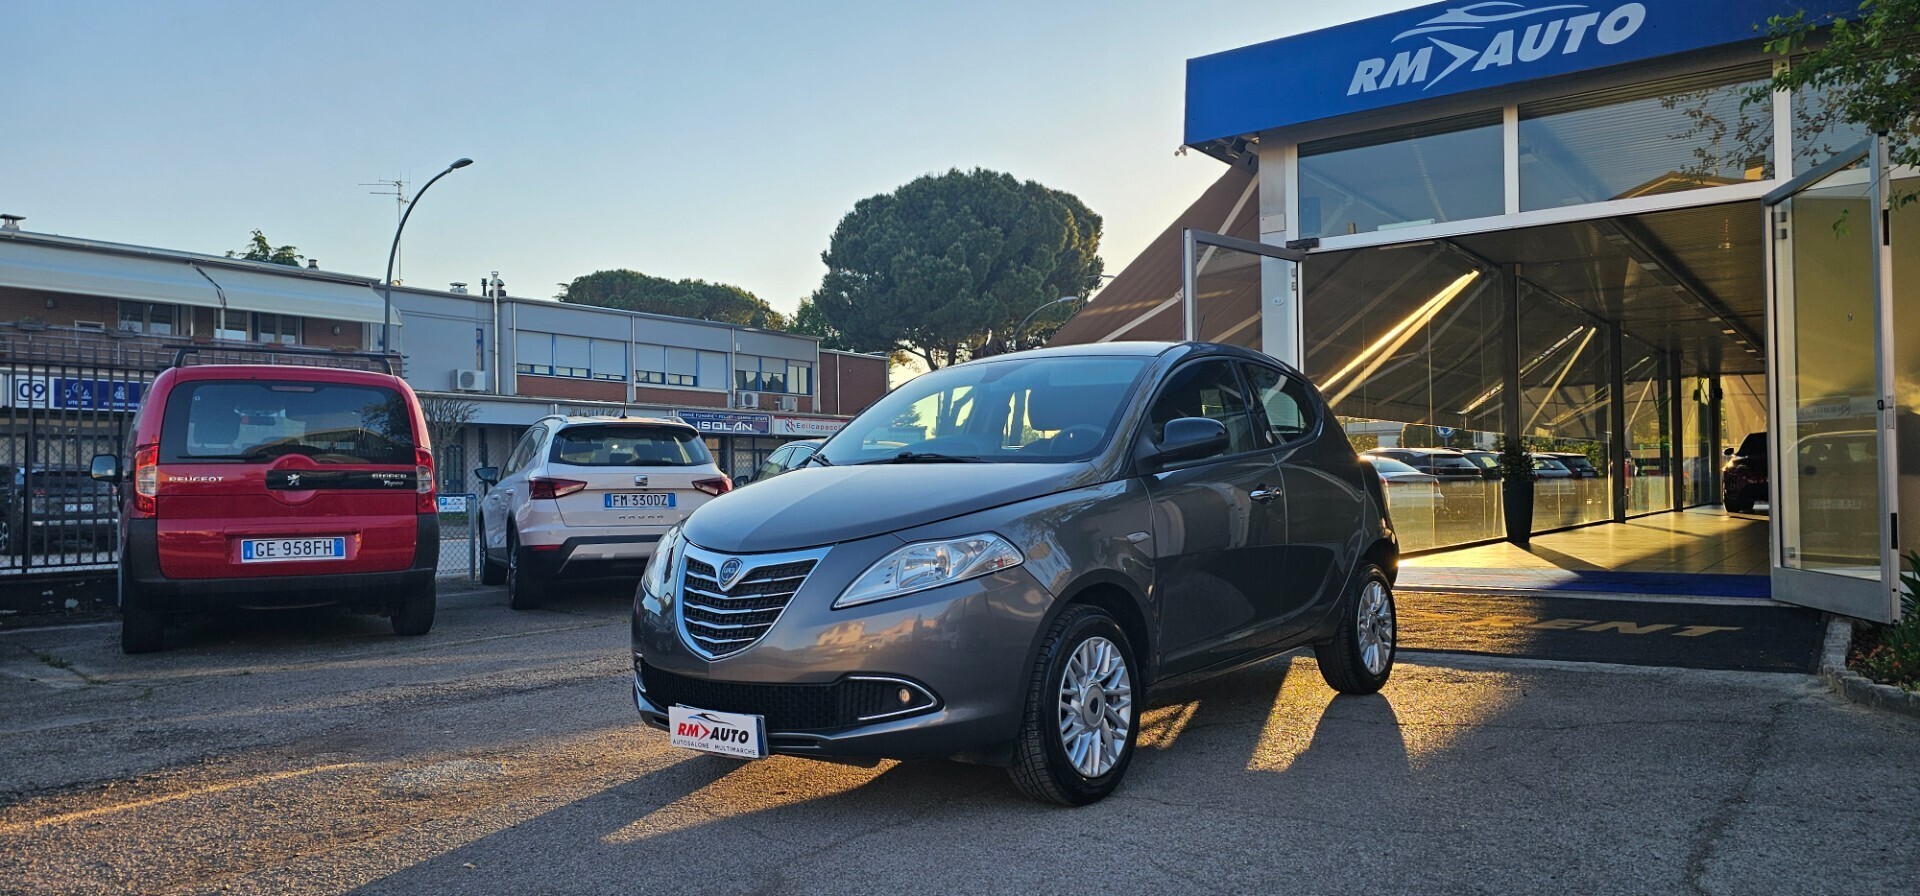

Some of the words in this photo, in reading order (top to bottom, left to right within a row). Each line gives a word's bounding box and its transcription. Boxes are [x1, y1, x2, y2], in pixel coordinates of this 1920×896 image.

[697, 421, 753, 433] ISOLAN
[612, 494, 628, 506] FM
[632, 494, 668, 506] 330DZ
[255, 542, 276, 557] GE
[282, 540, 332, 556] 958FH
[672, 738, 710, 749] AUTOSALONE
[714, 744, 756, 755] MULTIMARCHE
